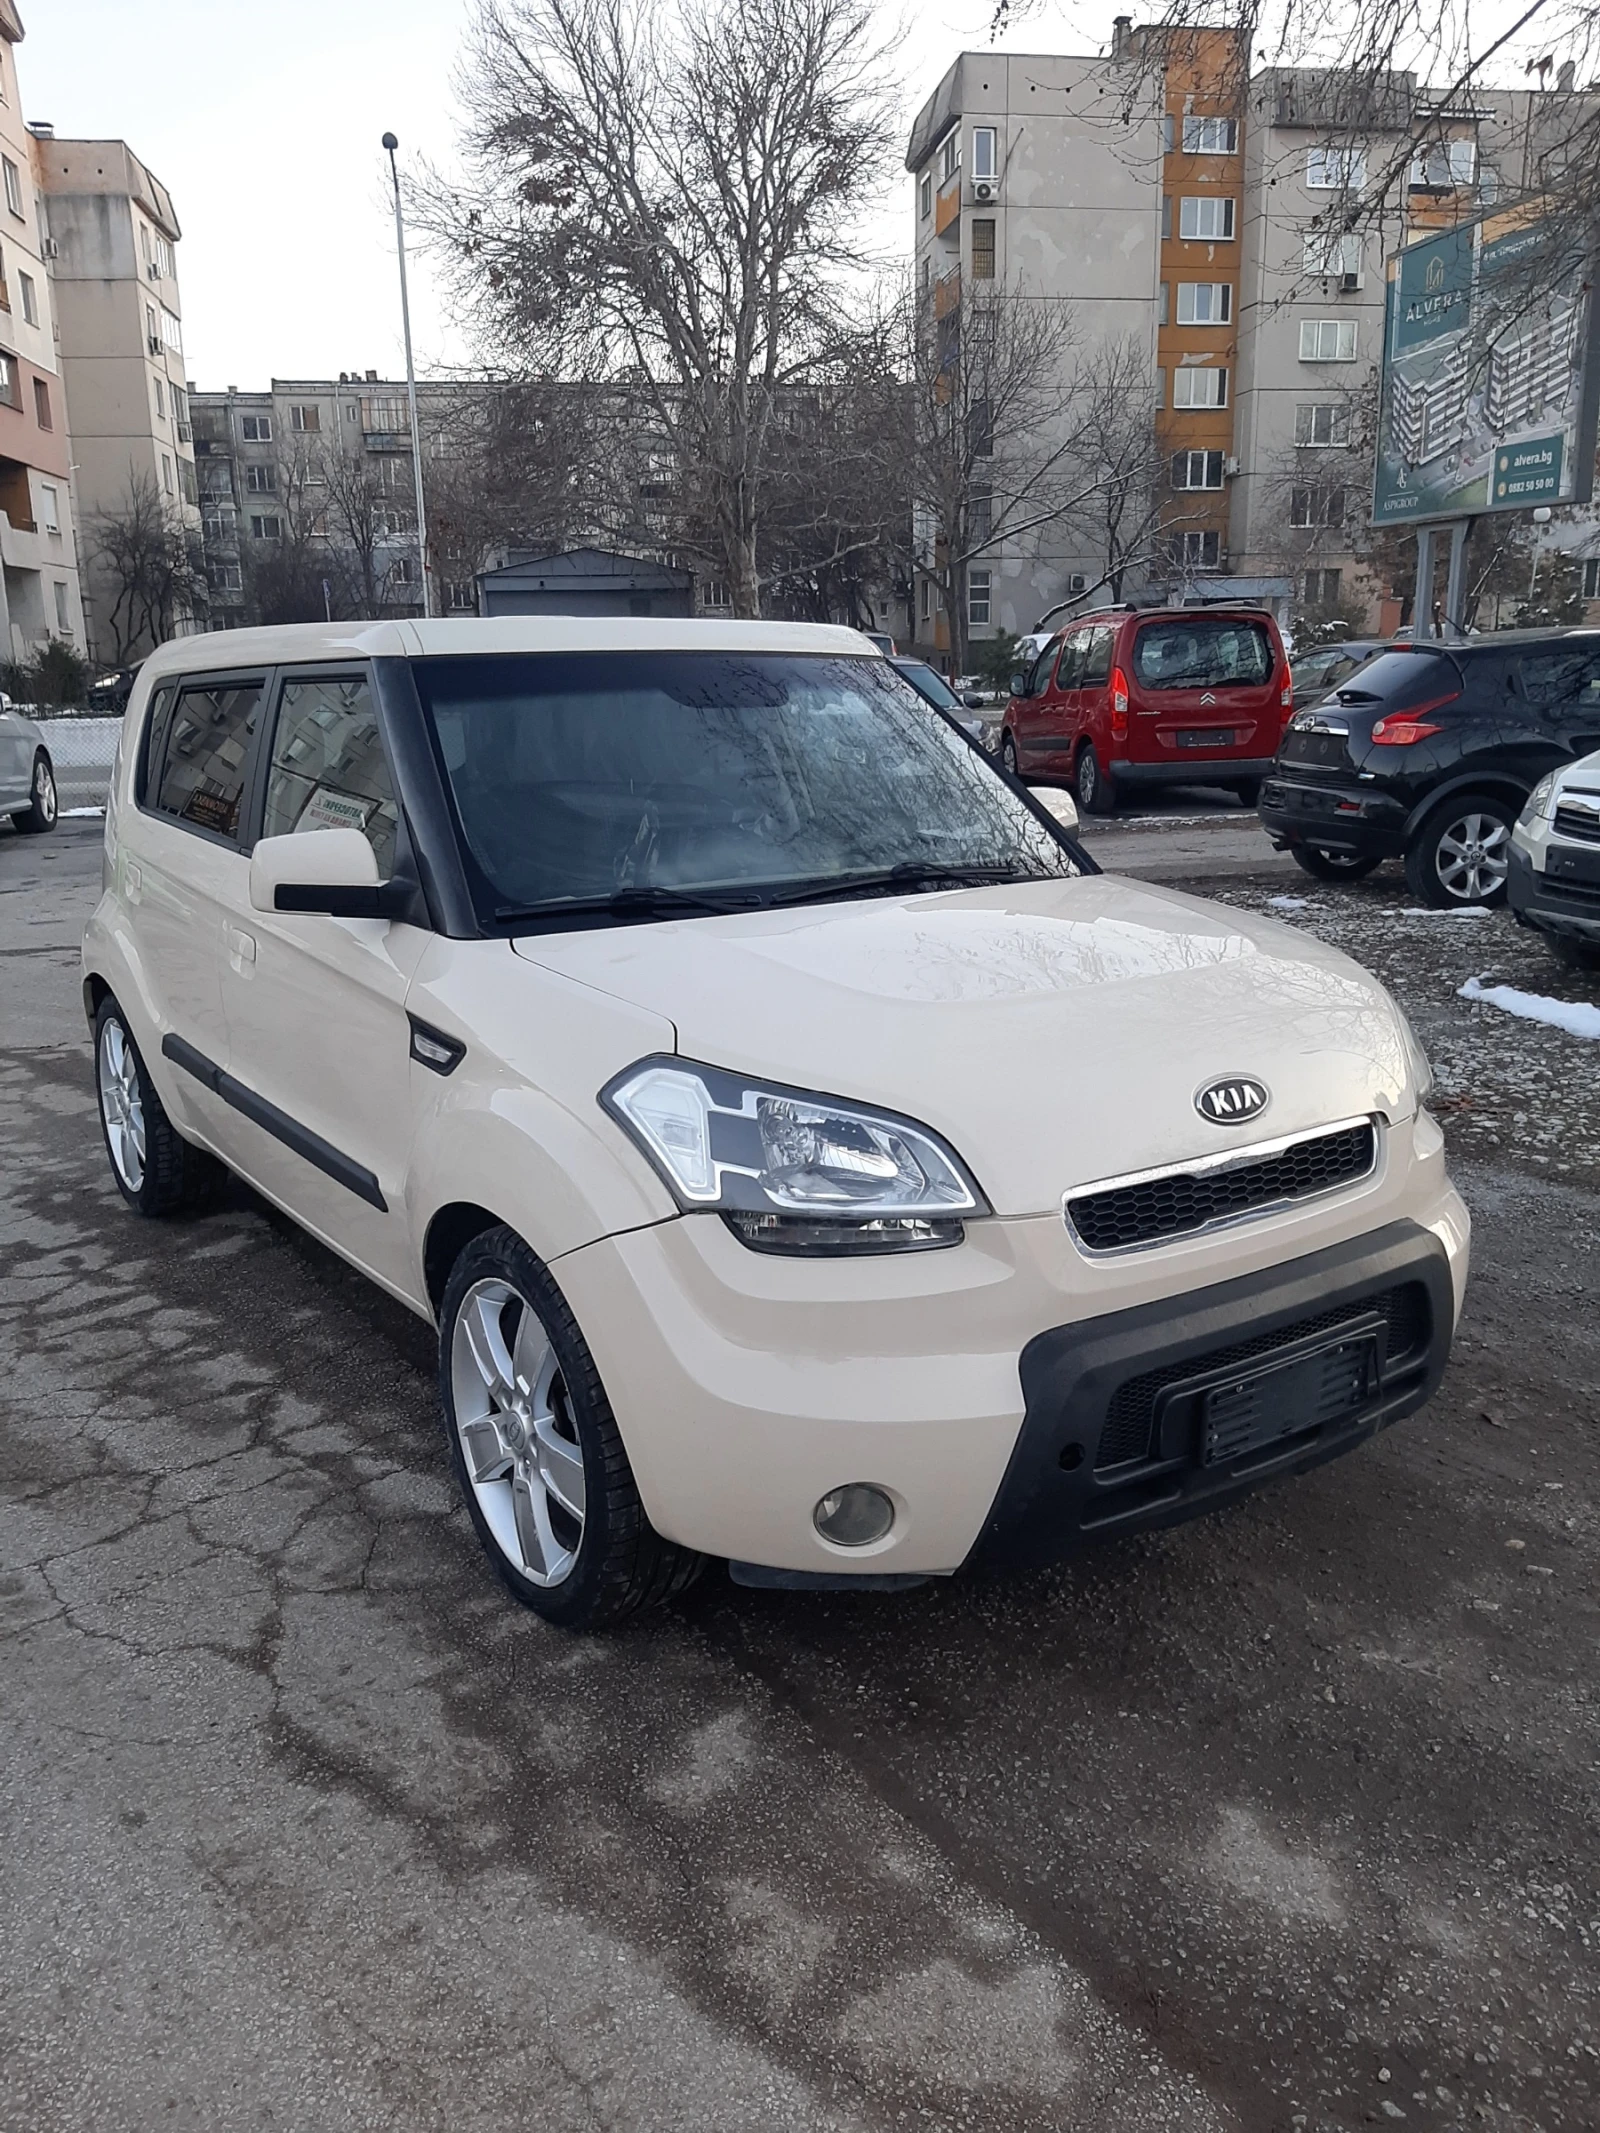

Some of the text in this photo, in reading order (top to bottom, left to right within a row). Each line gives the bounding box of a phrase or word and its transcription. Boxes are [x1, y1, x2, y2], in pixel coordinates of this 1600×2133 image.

[1514, 449, 1553, 467] alvera.bg
[1508, 477, 1554, 493] 0882 50 50 00
[1207, 1084, 1262, 1116] KIA
